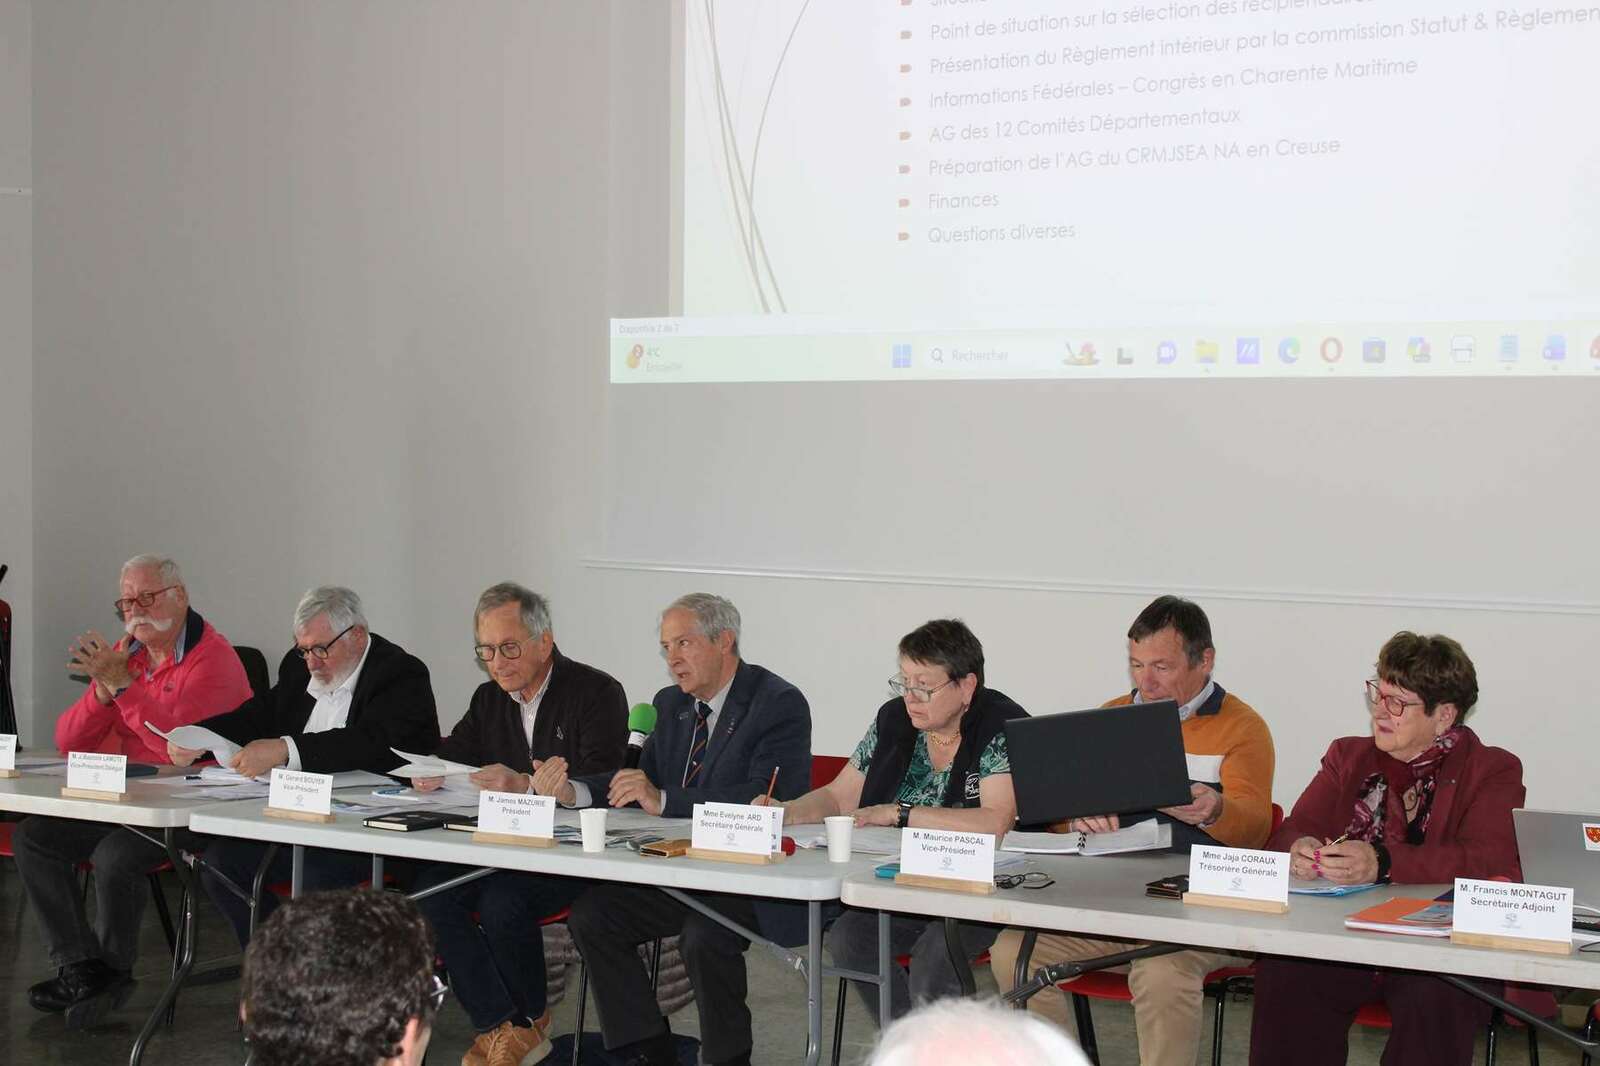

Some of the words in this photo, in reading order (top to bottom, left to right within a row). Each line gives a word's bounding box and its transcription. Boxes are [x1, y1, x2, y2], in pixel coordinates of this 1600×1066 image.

[930, 22, 969, 40] Point
[974, 19, 997, 36] de
[1001, 14, 1069, 34] situation
[1074, 14, 1097, 27] sur
[1102, 8, 1117, 24] la
[1122, 3, 1200, 23] sélection
[1206, 0, 1237, 16] des
[930, 53, 1030, 74] Présentation
[1034, 49, 1057, 66] du
[1062, 40, 1154, 66] Règlement
[1236, 35, 1267, 52] par
[1273, 29, 1289, 47] la
[1295, 21, 1404, 45] commission
[1409, 15, 1467, 36] Statut
[1474, 12, 1489, 31] &
[930, 88, 1029, 109] Informations
[1033, 80, 1114, 101] Fédérales
[1133, 72, 1206, 95] Congrès
[1211, 74, 1235, 88] en
[1240, 65, 1328, 86] Charente
[1335, 58, 1418, 78] Maritime
[929, 125, 956, 143] AG
[961, 124, 988, 141] des
[996, 121, 1013, 138] 12
[1017, 117, 1085, 136] Comités
[1090, 107, 1241, 132] Départementaux
[929, 156, 1023, 178] Préparation
[1028, 153, 1050, 170] de
[1098, 150, 1121, 166] du
[1126, 143, 1208, 165] CRMJSEA
[1214, 142, 1241, 159] NA
[1246, 144, 1269, 158] en
[1275, 138, 1341, 156] Creuse
[928, 192, 1000, 209] Finances
[928, 225, 1005, 243] Questions
[1010, 223, 1076, 240] diverses
[496, 796, 517, 805] James
[502, 806, 531, 816] Président
[703, 809, 718, 818] Mme
[720, 810, 745, 820] Evelyne
[700, 819, 734, 831] Secrétaire
[735, 822, 764, 833] Générale
[912, 831, 922, 840] M.
[924, 833, 953, 843] Maurice
[954, 836, 985, 846] PASCAL
[921, 843, 976, 856] Vice-Président
[1202, 850, 1221, 860] Mme
[1222, 852, 1239, 863] Jaja
[1241, 854, 1277, 865] CORAUX
[1199, 862, 1240, 874] Trésorière
[1241, 866, 1278, 878] Générale
[1460, 883, 1471, 893] M.
[1473, 884, 1508, 896] Francis
[1510, 887, 1568, 902] MONTAGUT
[1470, 896, 1520, 910] Secrétaire
[1521, 902, 1556, 914] Adjoint
